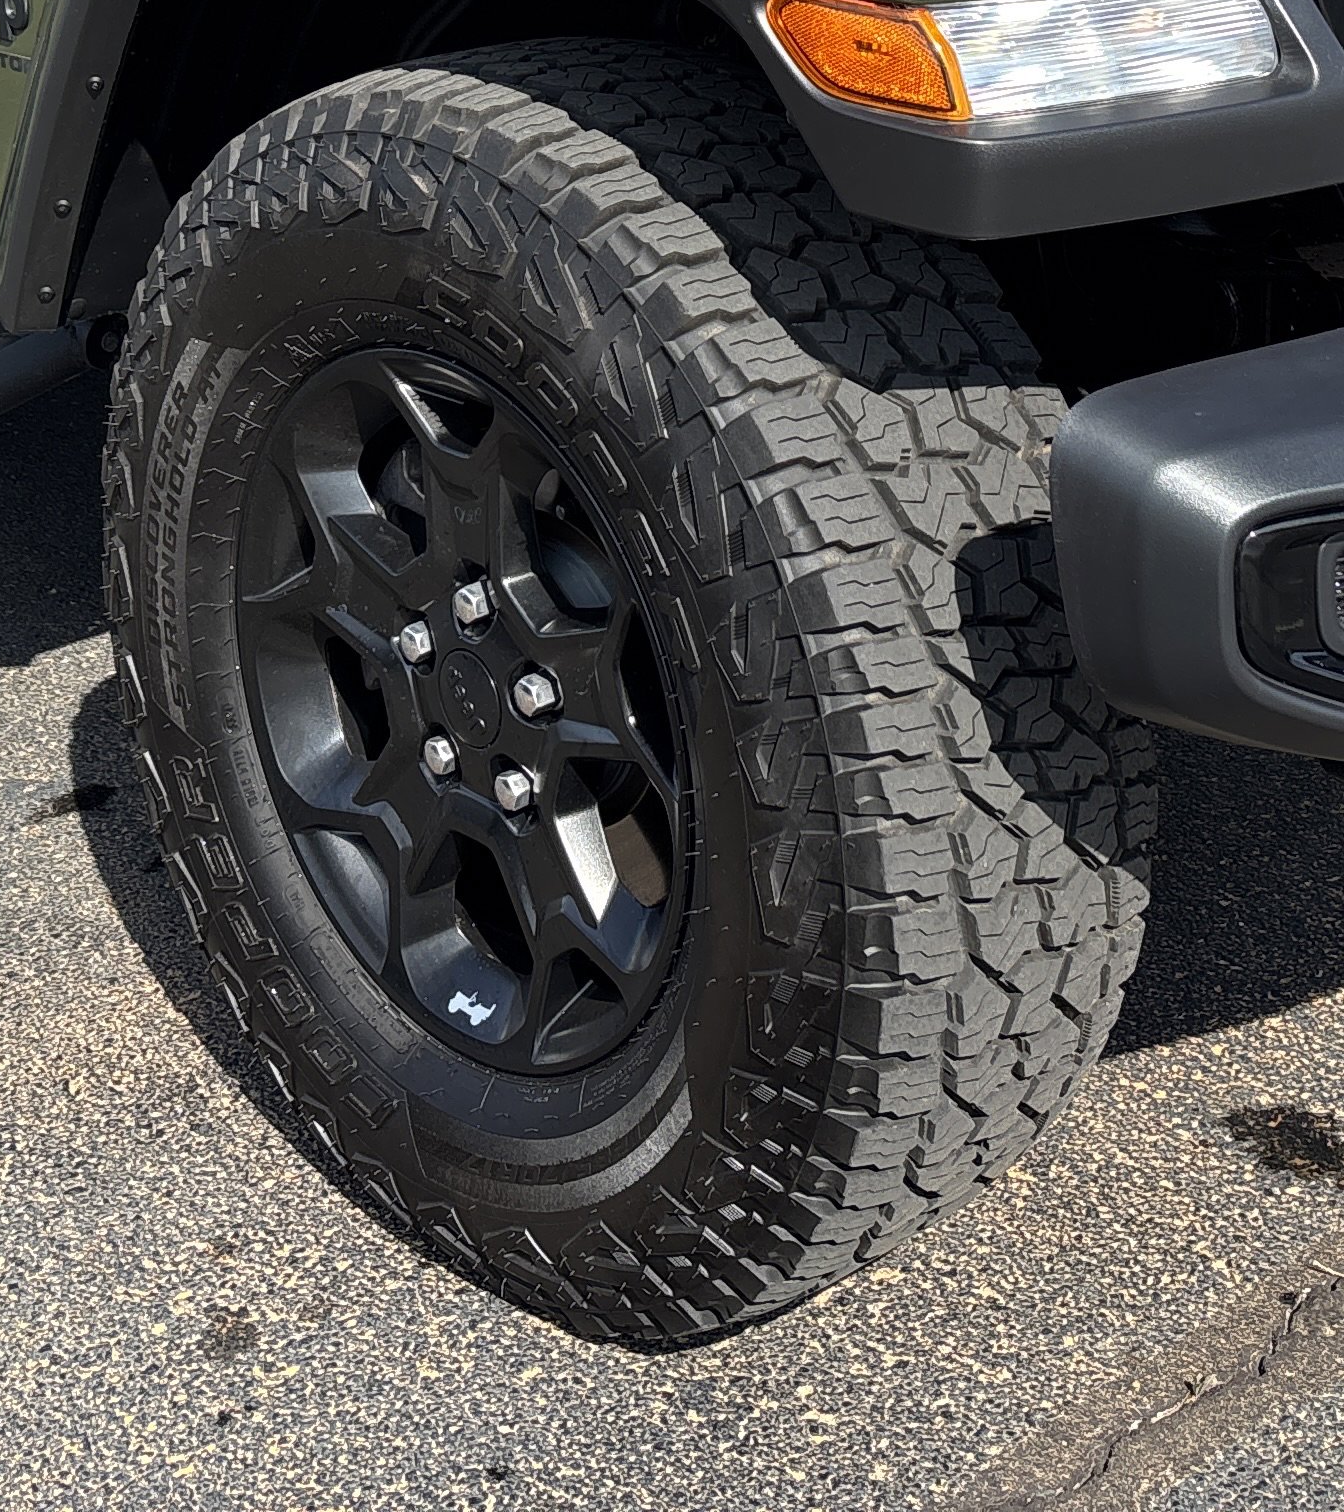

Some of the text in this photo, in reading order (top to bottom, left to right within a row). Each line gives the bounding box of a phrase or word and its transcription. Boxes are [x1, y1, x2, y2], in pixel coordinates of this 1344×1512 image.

[147, 379, 189, 646] DISCOVERER
[161, 422, 198, 709] STRONGHOLD
[420, 268, 702, 673] COOPER
[166, 749, 403, 1130] COOPER
